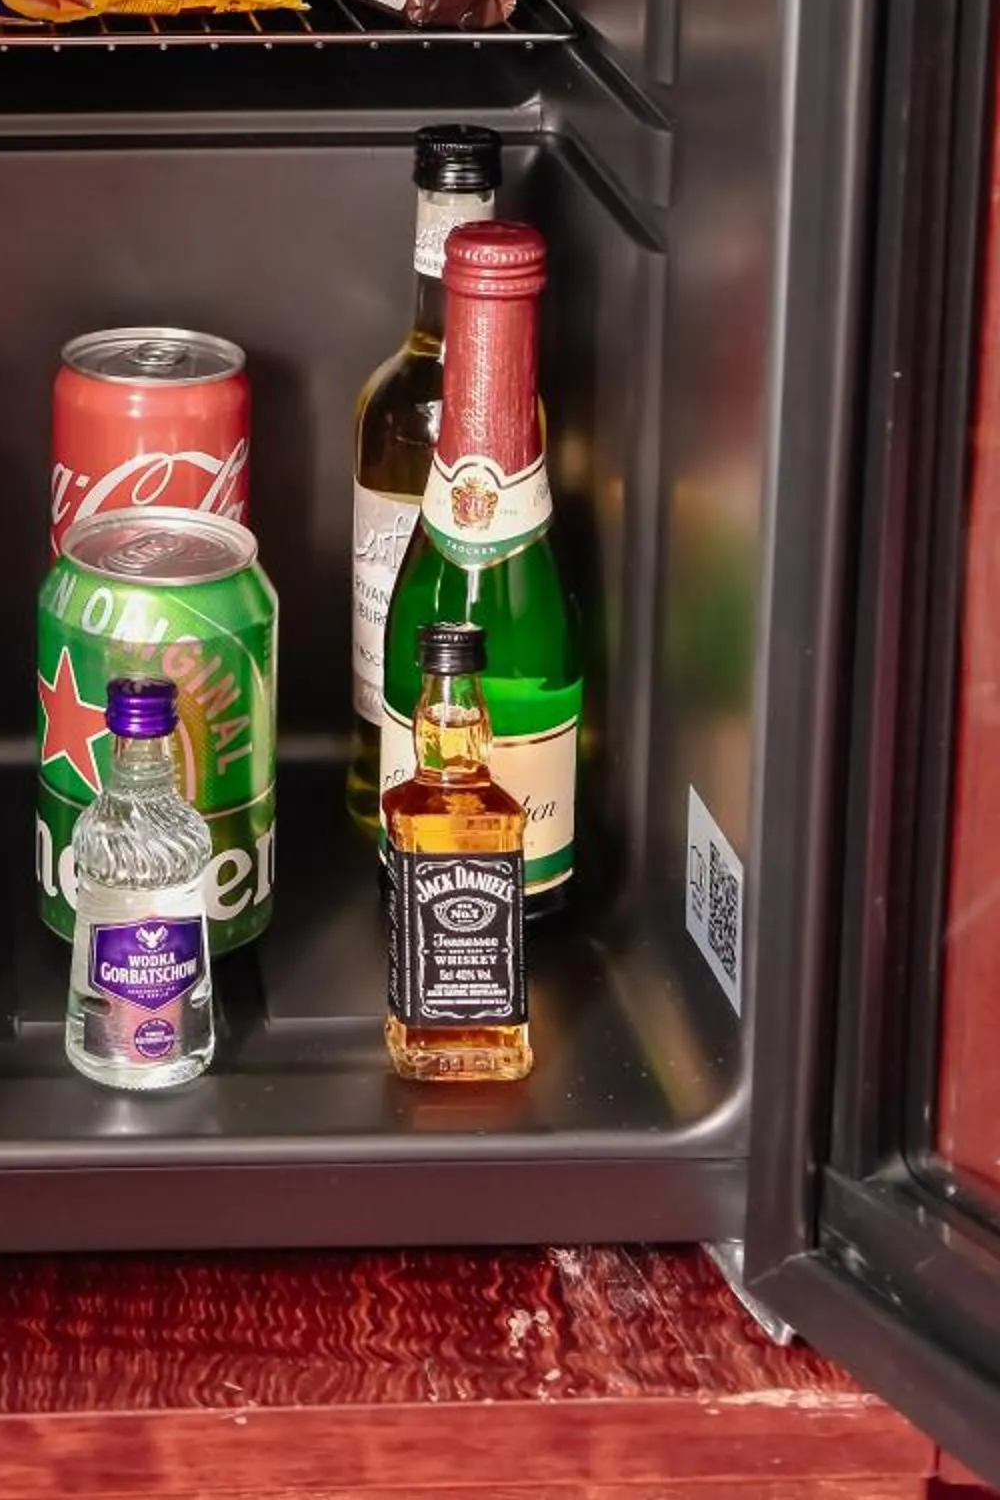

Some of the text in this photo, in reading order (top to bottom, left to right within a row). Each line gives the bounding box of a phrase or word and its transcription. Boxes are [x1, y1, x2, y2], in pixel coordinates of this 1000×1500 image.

[415, 872, 455, 903] JACK
[128, 952, 176, 967] WODKA
[434, 955, 498, 965] WHISKEY
[101, 958, 197, 984] GORBATSCHOW
